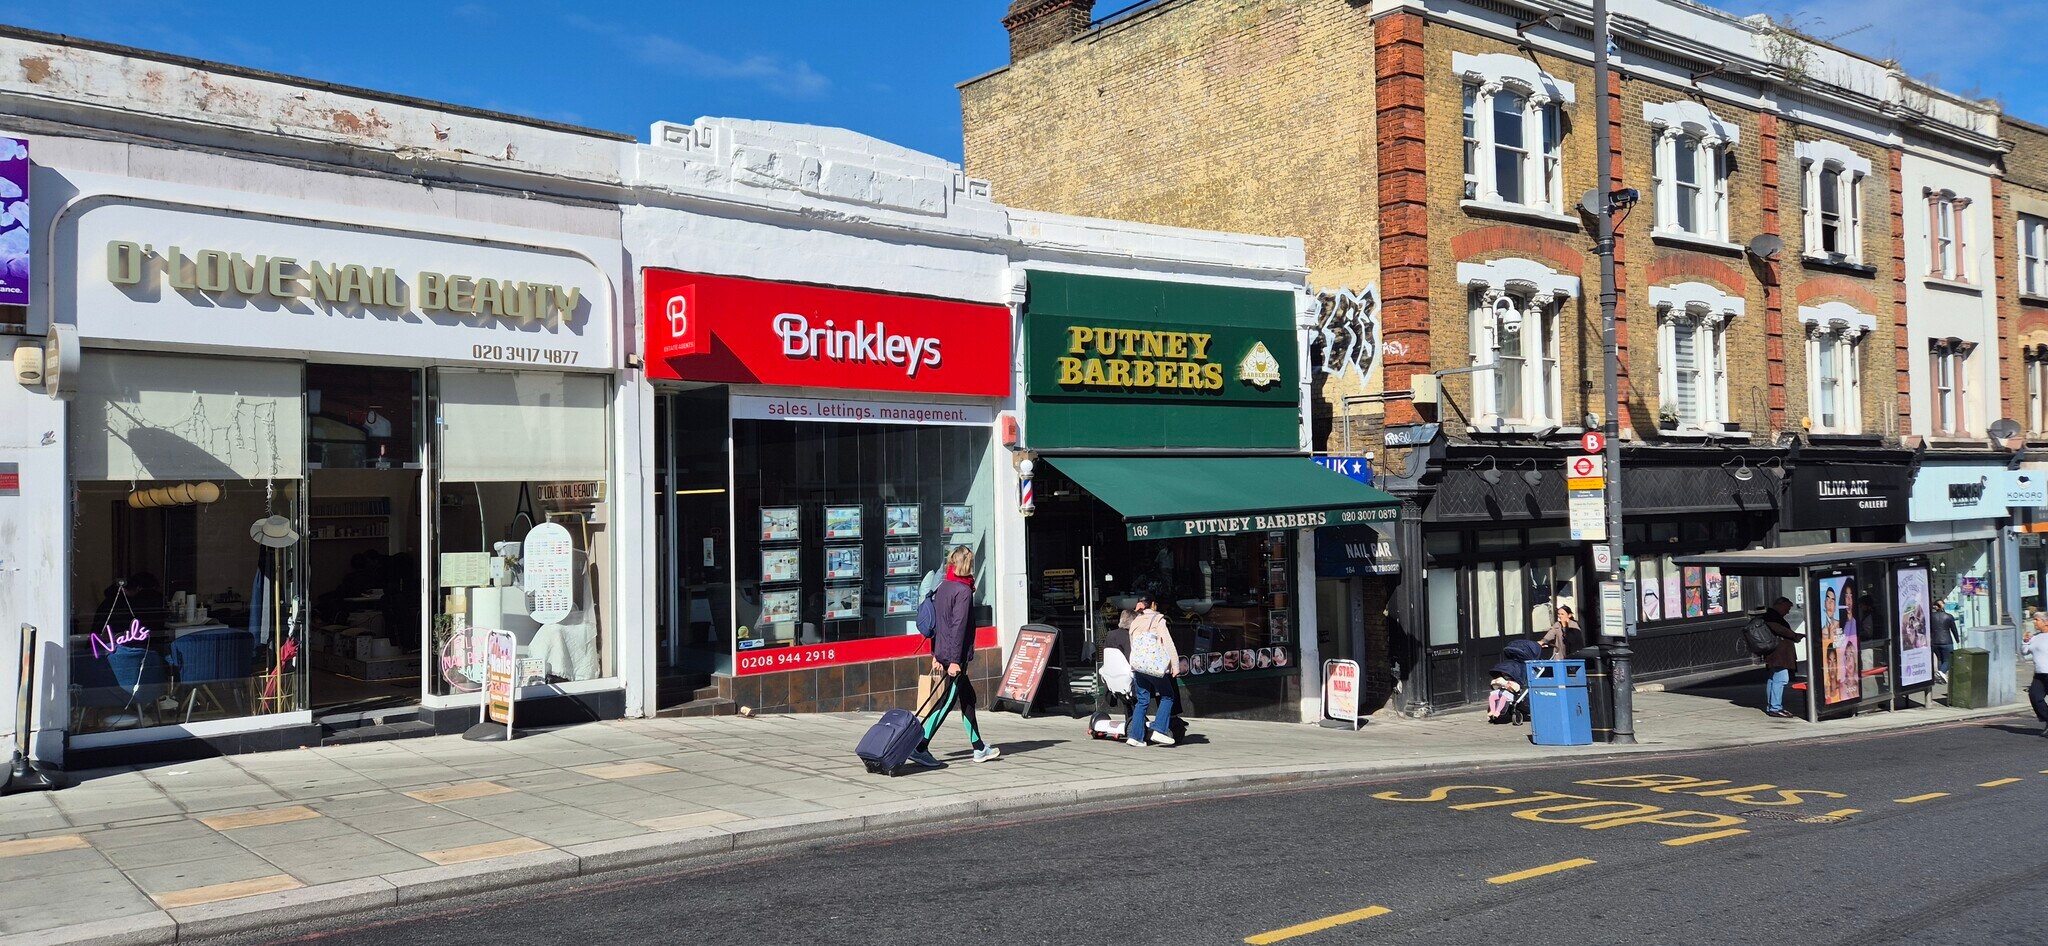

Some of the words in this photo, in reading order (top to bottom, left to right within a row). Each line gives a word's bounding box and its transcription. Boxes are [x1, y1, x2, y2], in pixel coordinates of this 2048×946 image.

[168, 245, 298, 297] LOVE
[310, 259, 407, 308] NAIL
[418, 271, 581, 321] BEAUTY
[666, 295, 687, 338] B
[773, 312, 942, 376] Brinkleys
[1068, 325, 1212, 359] PUTNEY
[472, 344, 503, 360] 020
[506, 346, 540, 362] 3417
[543, 349, 579, 365] 4877
[1057, 356, 1224, 390] BARBERS
[768, 401, 812, 415] sales.
[817, 402, 875, 420] lettings.
[880, 405, 967, 422] management.
[1586, 434, 1599, 450] B
[574, 483, 599, 498] BEAUTY
[1850, 480, 1870, 495] ART
[2006, 491, 2043, 499] KOKORO
[1133, 525, 1149, 536] 166
[1184, 517, 1250, 534] PUTNEY
[1255, 512, 1327, 529] BARBERS
[1341, 511, 1356, 522] 020
[1357, 510, 1376, 521] 3007
[1378, 508, 1397, 519] 0879
[1345, 543, 1371, 559] NAIL
[1371, 542, 1393, 558] BAR
[90, 618, 151, 659] Nails
[741, 655, 774, 668] 0208
[778, 653, 801, 664] 944
[805, 649, 835, 662] 2918
[1338, 665, 1355, 678] STAR
[1333, 680, 1352, 693] NAILS
[1571, 773, 1848, 806] BUS
[1370, 785, 1748, 830] STOP
